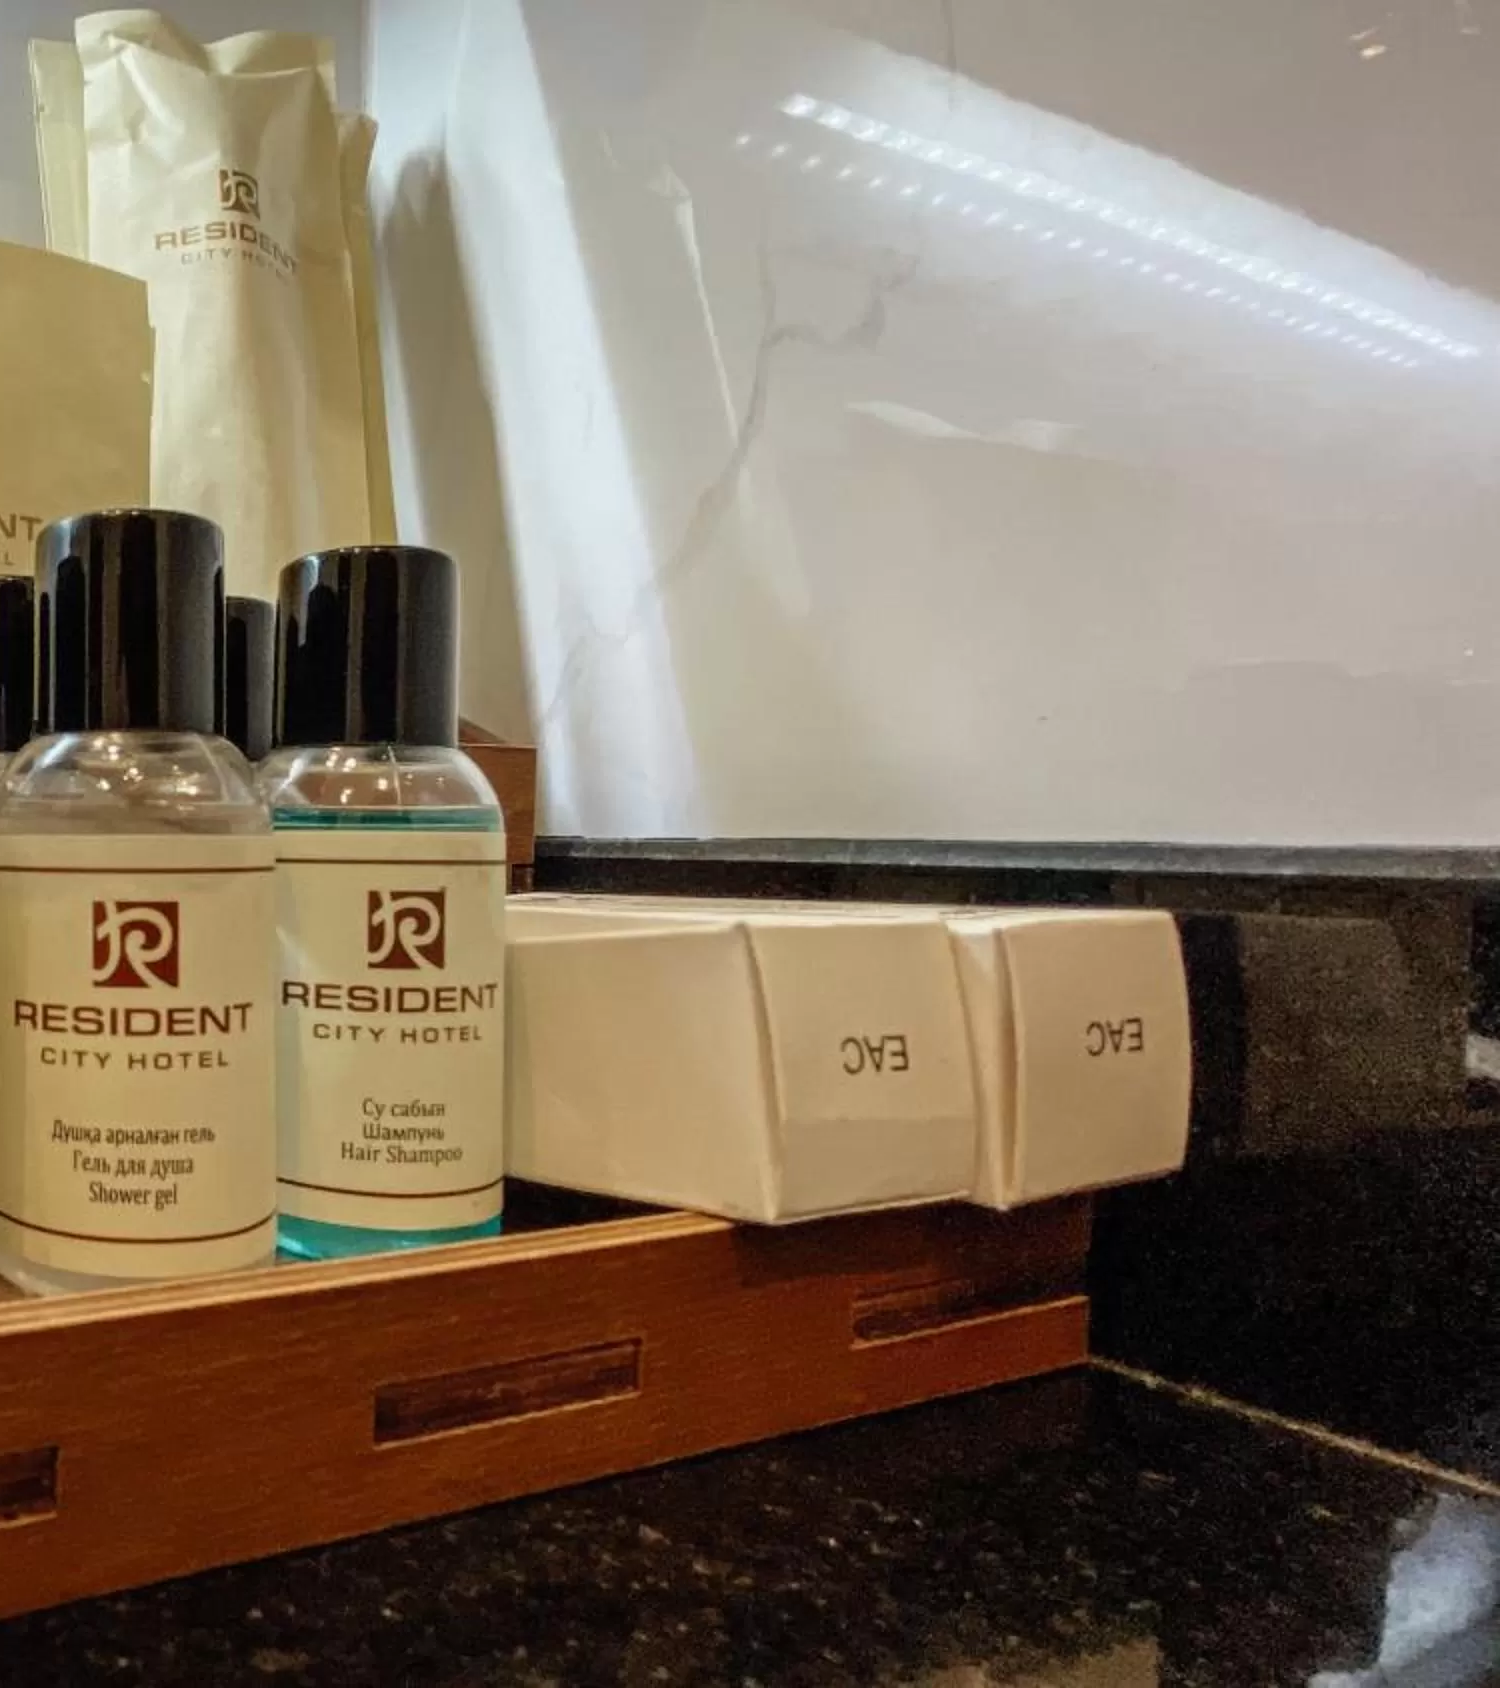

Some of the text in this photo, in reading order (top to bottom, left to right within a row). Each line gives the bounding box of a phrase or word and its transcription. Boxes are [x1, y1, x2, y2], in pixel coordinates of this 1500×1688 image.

[155, 220, 298, 276] RESIDENT
[281, 981, 498, 1014] RESIDENT
[14, 999, 253, 1037] RESIDENT
[312, 1023, 482, 1045] CITY HOTEL
[1086, 1017, 1145, 1057] EAC
[40, 1047, 230, 1071] CITY HOTEL
[841, 1035, 911, 1075] EAC
[363, 1098, 446, 1121] Су сабын
[183, 1127, 216, 1143] гель
[363, 1123, 445, 1144] Шампунь
[73, 1150, 194, 1181] Гель для душа
[341, 1141, 463, 1168] Hair Shampoo
[88, 1181, 178, 1212] Shower gel
